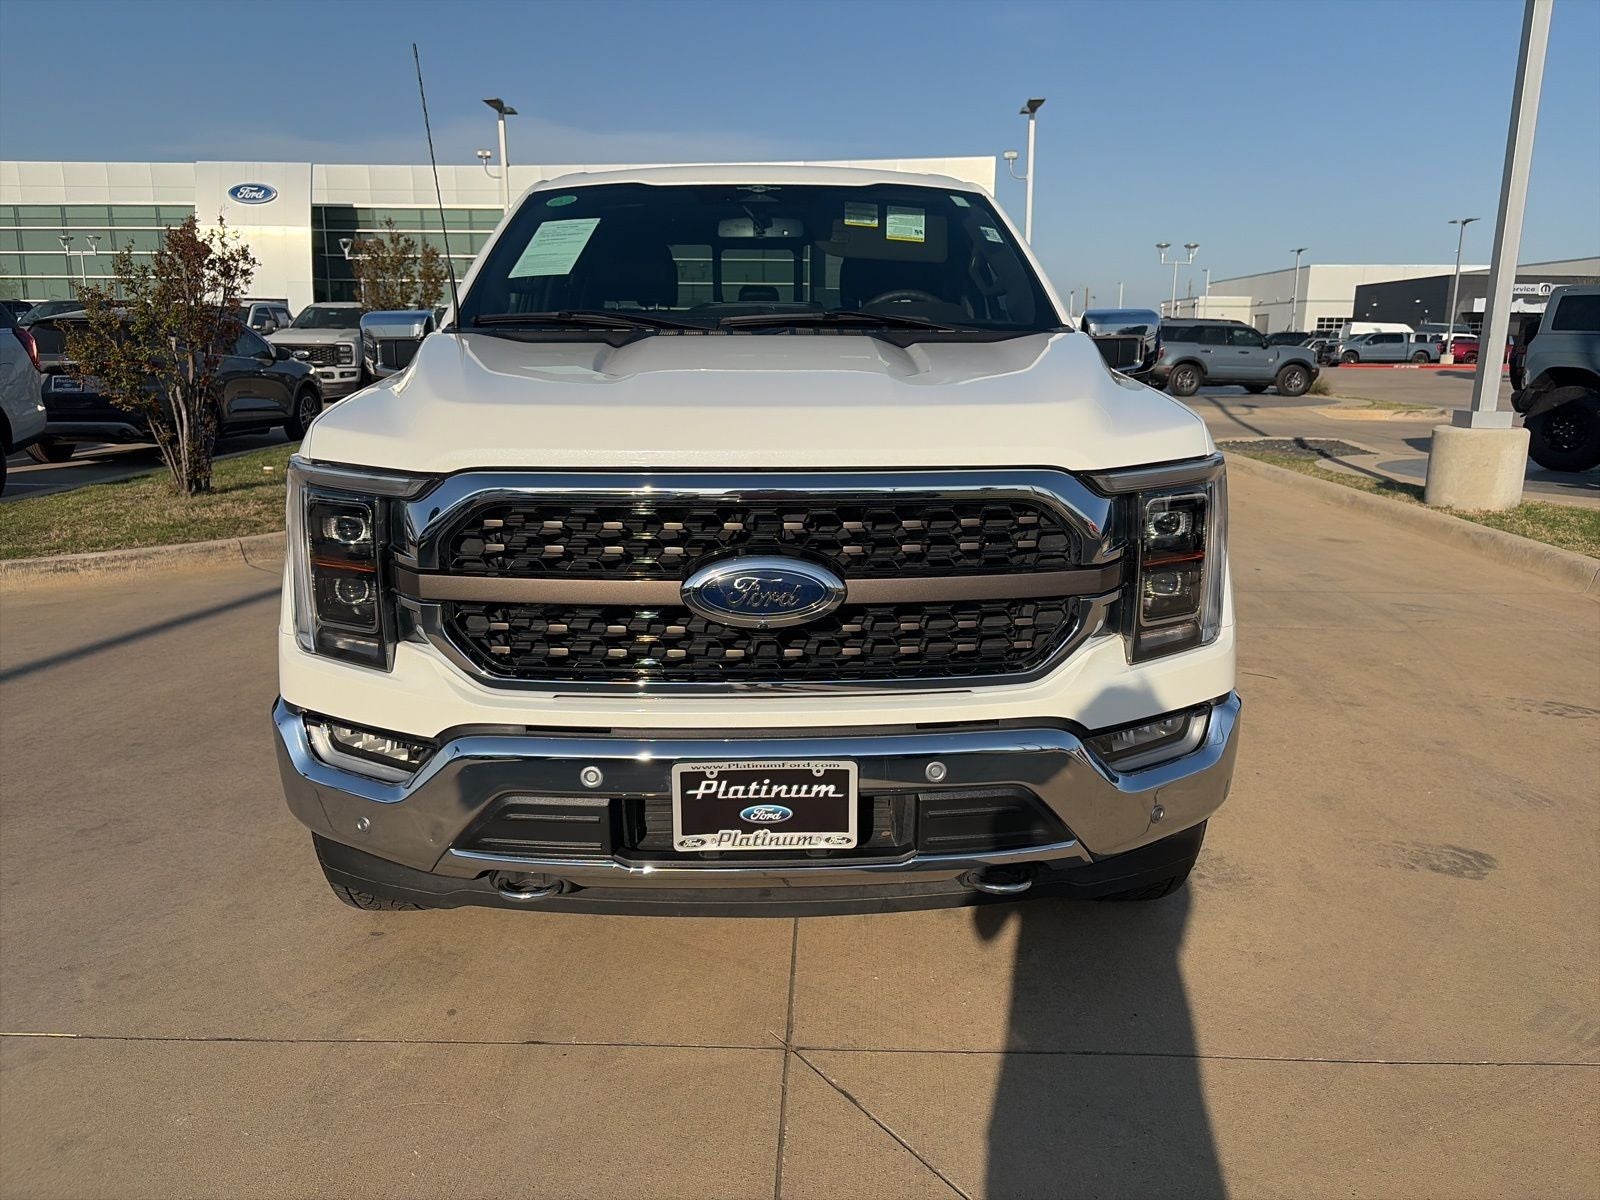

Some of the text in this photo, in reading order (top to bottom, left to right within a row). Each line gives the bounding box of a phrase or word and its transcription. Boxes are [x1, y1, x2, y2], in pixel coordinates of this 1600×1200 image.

[237, 186, 265, 199] Ford
[726, 576, 802, 607] Ford
[691, 762, 840, 770] www.PlatinumFord.com
[686, 779, 844, 799] Platinum
[750, 807, 783, 820] Ford
[718, 832, 818, 847] Platinum
